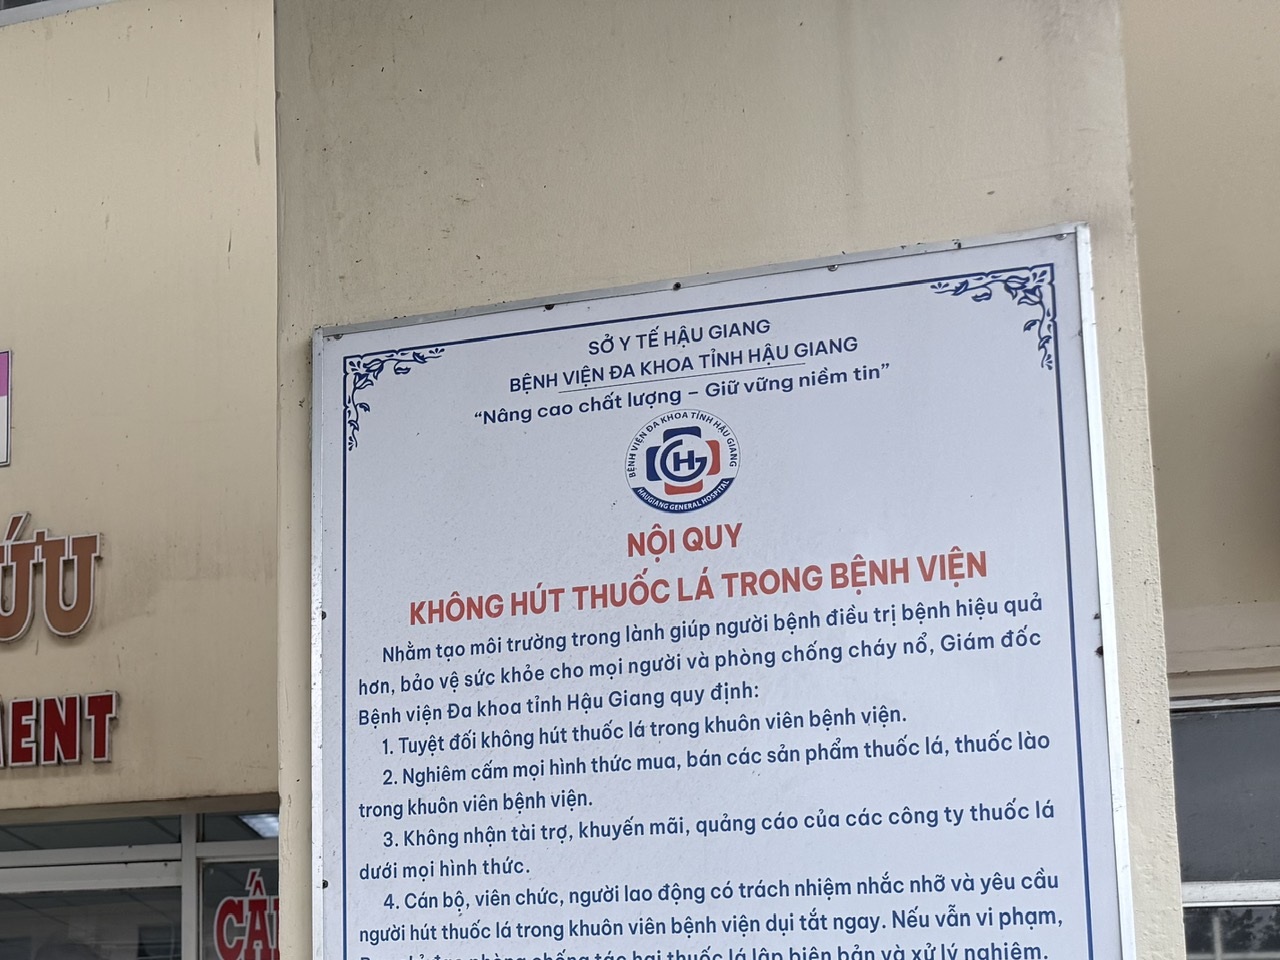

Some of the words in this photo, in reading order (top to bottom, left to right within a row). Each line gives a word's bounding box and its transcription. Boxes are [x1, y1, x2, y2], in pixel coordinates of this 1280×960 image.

[588, 333, 615, 356] SỞ
[618, 335, 632, 352] Y
[635, 325, 660, 350] TẾ
[663, 324, 704, 349] HẬU
[708, 318, 772, 340] GIANG
[509, 372, 558, 395] BỆNH
[562, 364, 605, 388] VIỆN
[608, 363, 636, 380] ĐA
[640, 356, 695, 377] KHOA
[698, 347, 743, 369] TỈNH
[748, 342, 789, 366] HẬU
[793, 335, 859, 358] GIANG
[474, 407, 533, 425] “Nâng
[537, 403, 574, 419] cao
[578, 391, 623, 414] chất
[627, 389, 682, 410] lượng
[704, 379, 740, 398] Giữ
[743, 376, 794, 394] vững
[798, 366, 848, 388] niềm
[852, 362, 890, 382] tin”
[646, 421, 660, 433] ĐA
[660, 413, 688, 424] KHOA
[692, 411, 714, 424] TỈNH
[726, 437, 737, 467] GIANG
[638, 488, 668, 510] HAUGIANG
[669, 501, 702, 510] GENERAL
[701, 480, 729, 504] HOSPITAL
[627, 523, 675, 564] NỘI
[682, 522, 743, 552] QUY
[409, 590, 504, 626] KHÔNG
[510, 581, 566, 617] HÚT
[571, 573, 671, 611] THUỐC
[677, 566, 715, 602] LÁ
[720, 564, 823, 598] TRONG
[830, 557, 910, 596] BỆNH
[916, 550, 987, 588] VIỆN
[382, 737, 394, 756] 1.
[397, 734, 445, 757] Tuyệt
[448, 728, 477, 751] đối
[481, 729, 535, 750] không
[539, 725, 568, 745] hút
[571, 719, 624, 742] thuốc
[628, 719, 646, 739] lá
[649, 721, 700, 739] trong
[704, 713, 761, 734] khuôn
[764, 710, 804, 730] viên
[808, 707, 856, 732] bệnh
[860, 704, 907, 729] viện.
